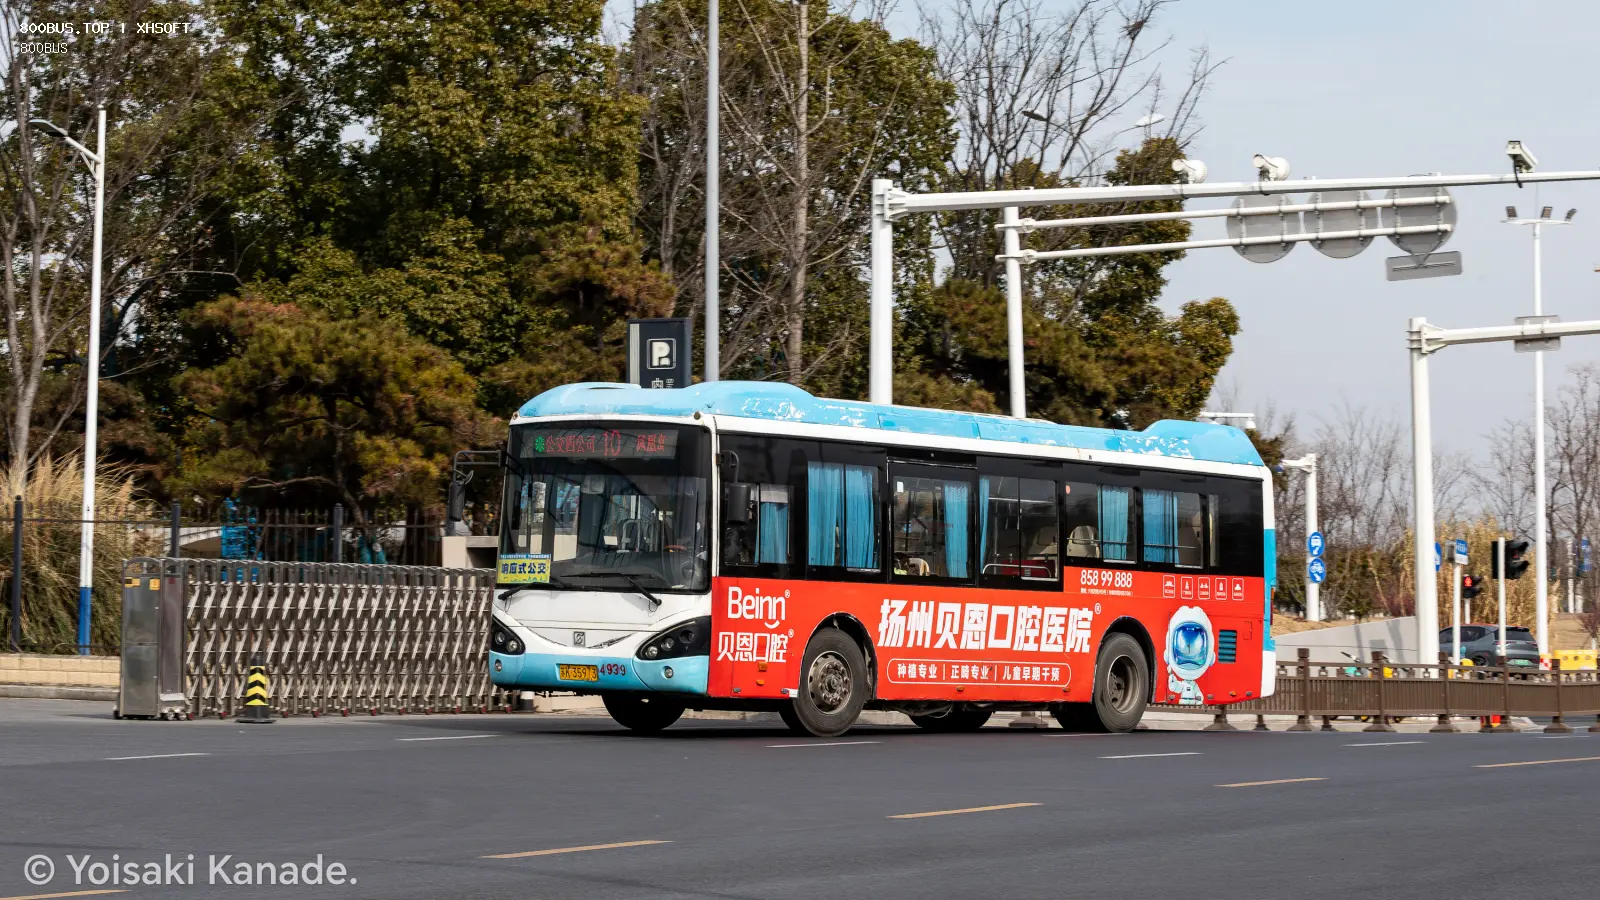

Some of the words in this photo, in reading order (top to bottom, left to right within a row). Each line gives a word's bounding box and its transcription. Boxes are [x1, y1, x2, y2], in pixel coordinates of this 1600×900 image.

[602, 429, 621, 456] 10
[1080, 569, 1099, 586] 858
[1101, 570, 1113, 587] 99
[1114, 571, 1133, 588] 888
[599, 663, 626, 676] 4939
[896, 663, 938, 679] 种植专业
[951, 664, 990, 680] 正畸专业
[1002, 665, 1060, 682] 儿童早期干预
